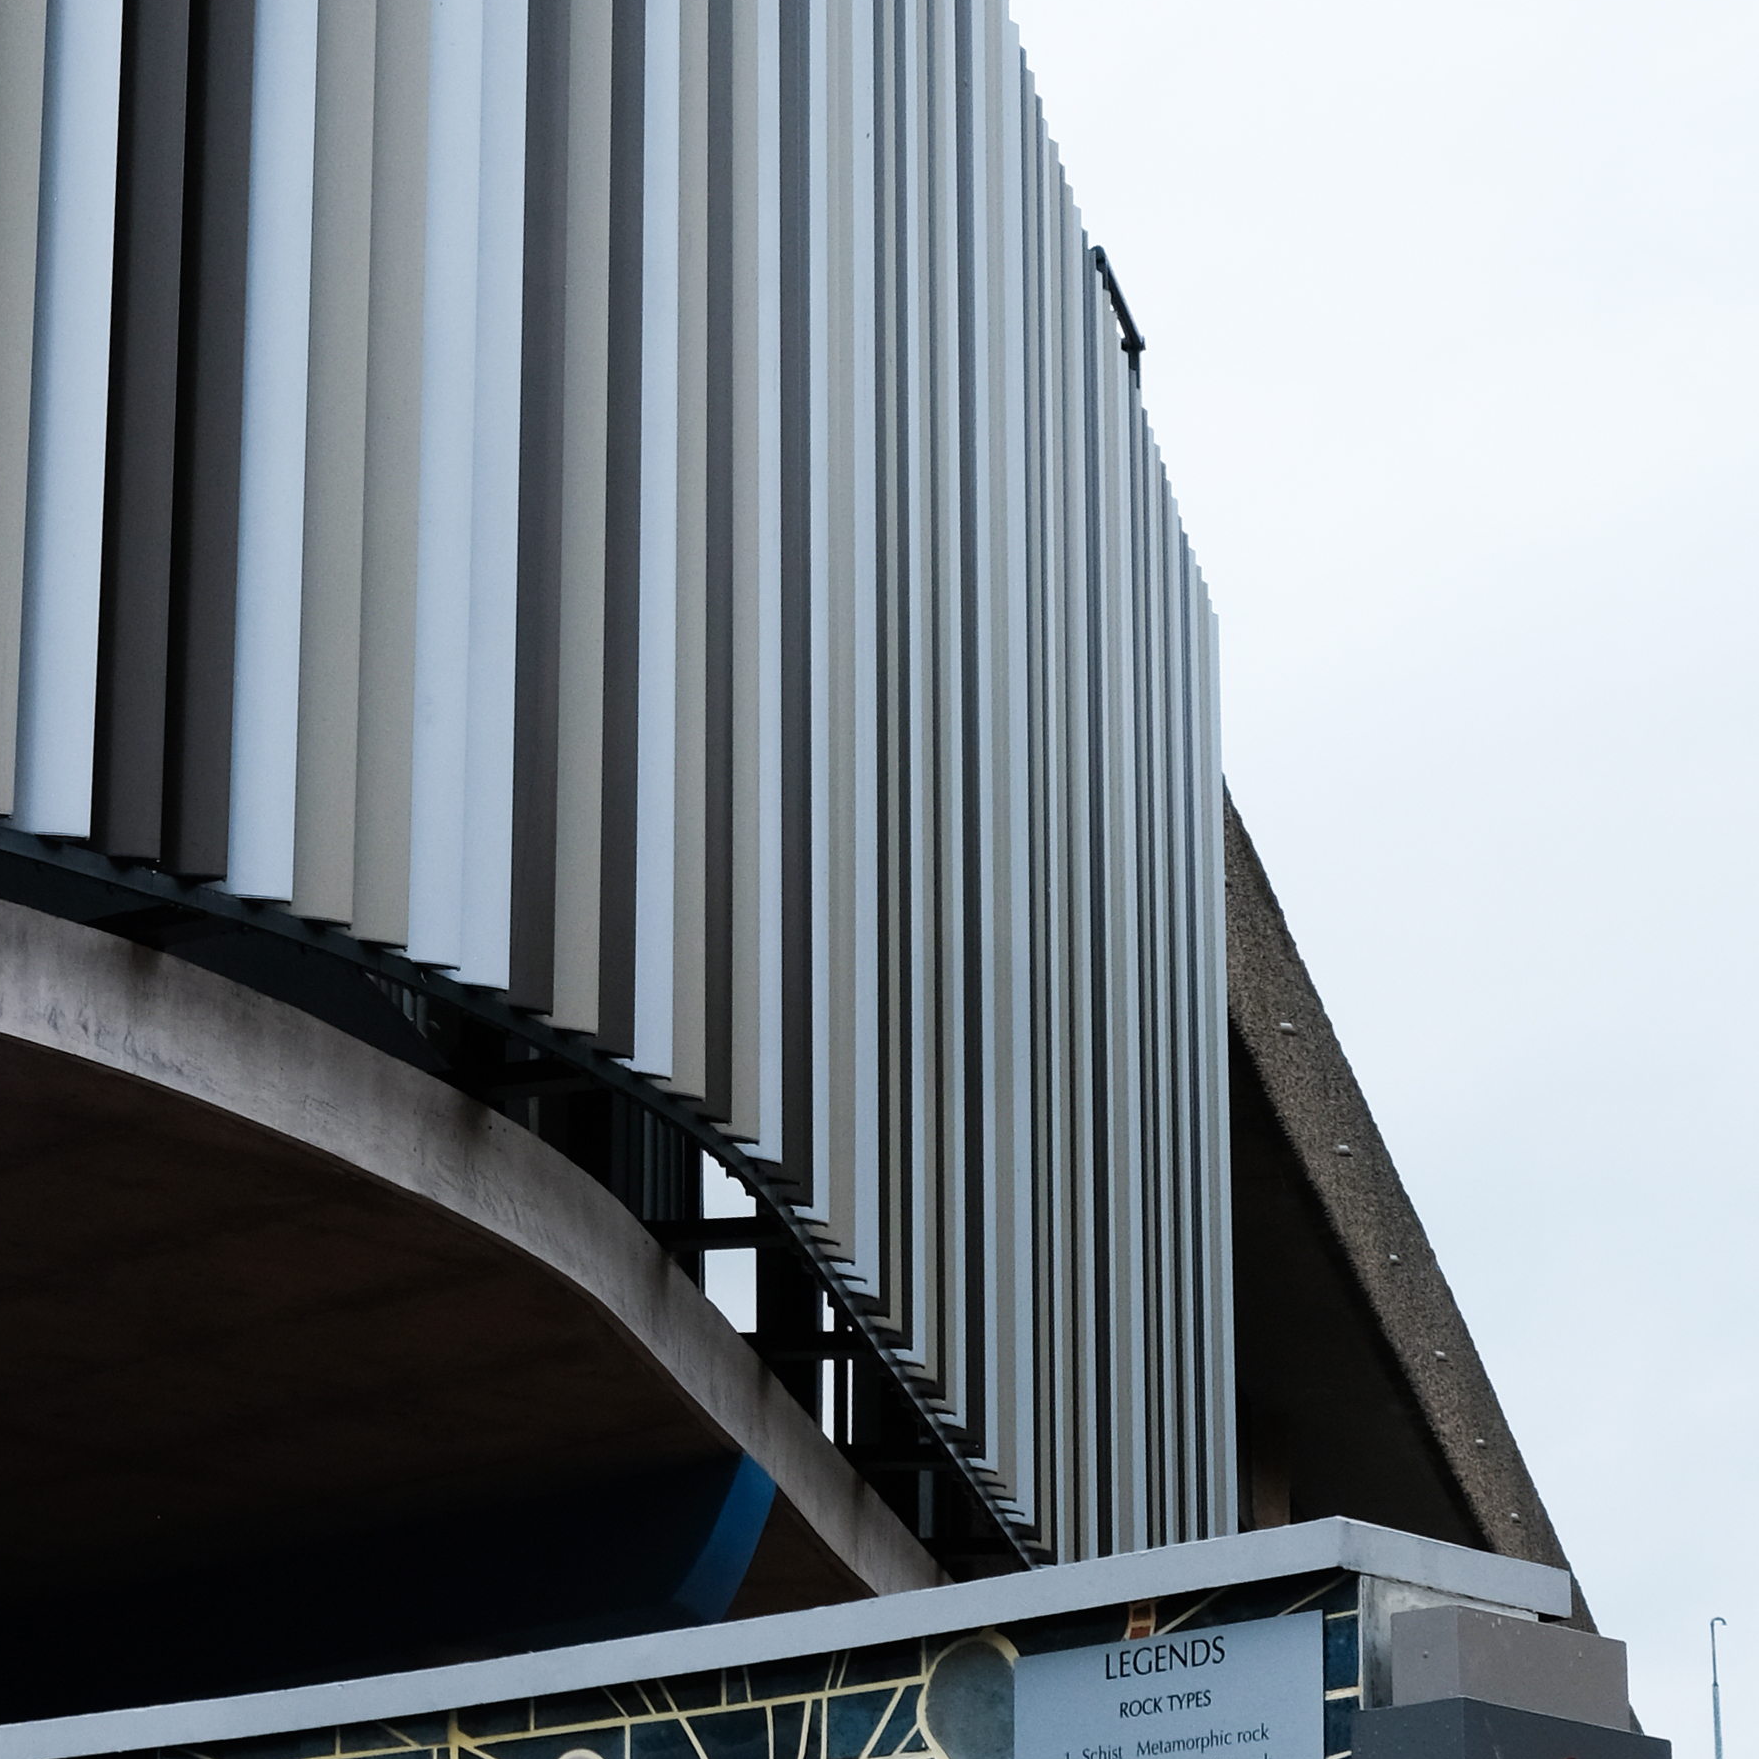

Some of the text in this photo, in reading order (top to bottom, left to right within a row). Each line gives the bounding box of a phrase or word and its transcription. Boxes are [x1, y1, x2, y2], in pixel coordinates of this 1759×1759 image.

[1106, 1636, 1225, 1680] LEGENDS
[1120, 1690, 1211, 1718] ROCK TYPES
[1137, 1729, 1231, 1756] Metamorphic
[1238, 1723, 1269, 1743] rock
